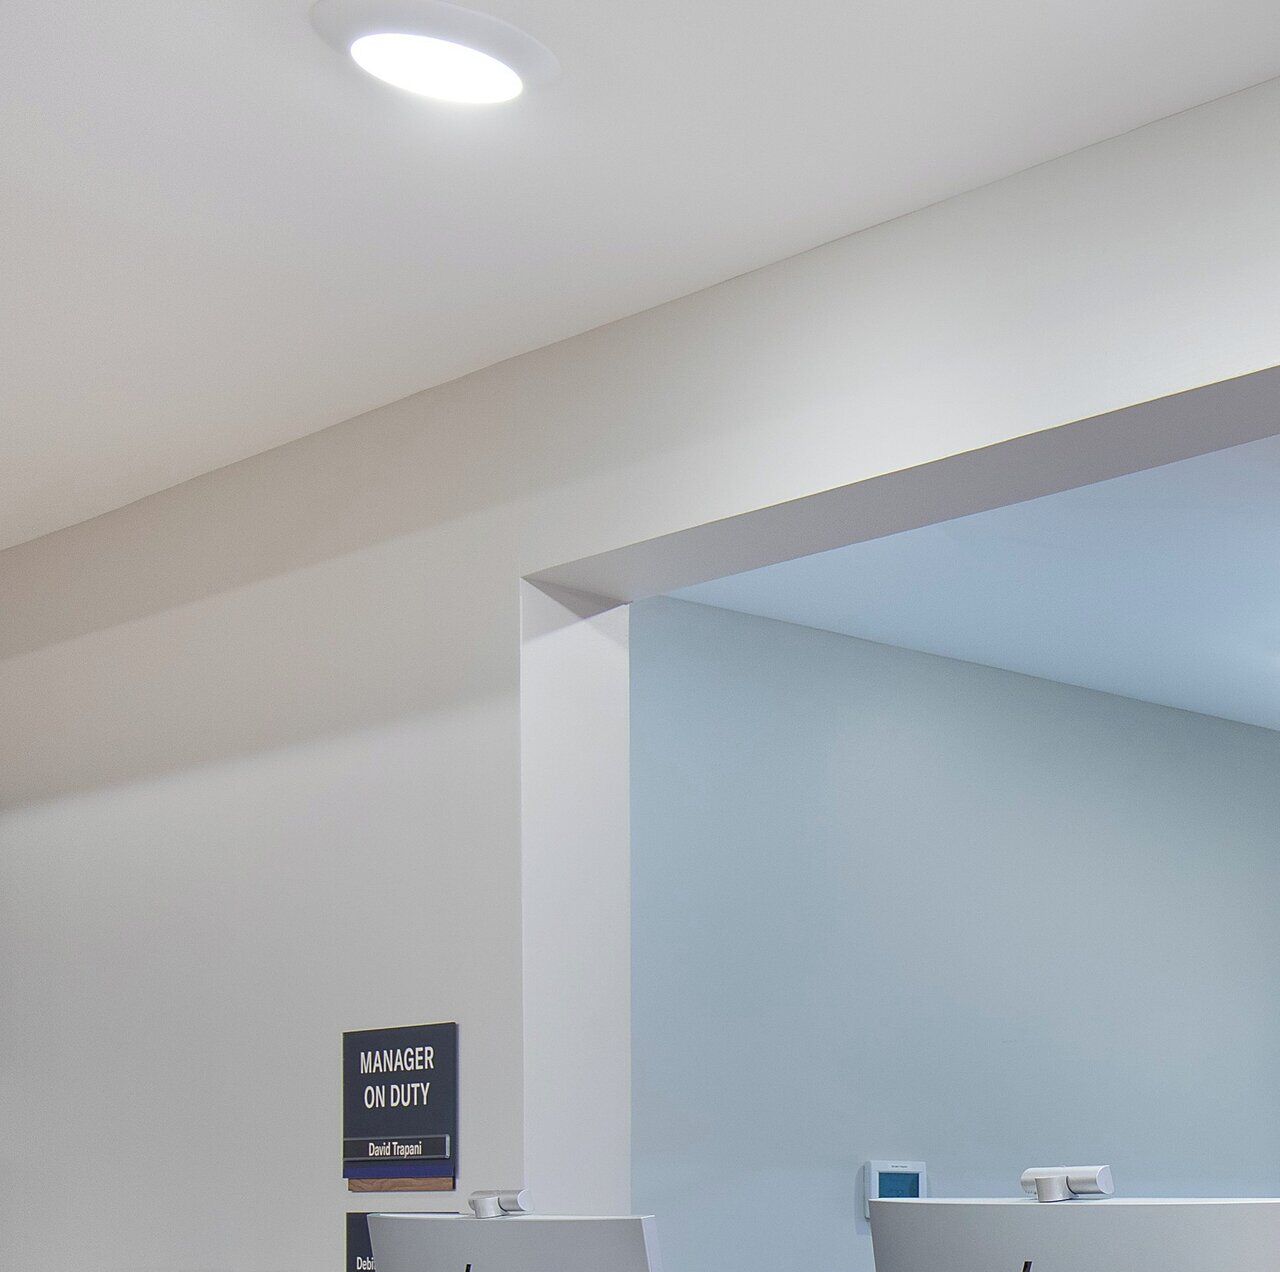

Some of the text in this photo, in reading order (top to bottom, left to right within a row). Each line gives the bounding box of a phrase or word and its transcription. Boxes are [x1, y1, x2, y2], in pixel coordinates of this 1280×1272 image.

[360, 1046, 434, 1074] MANAGER
[364, 1082, 430, 1109] ON DUTY
[368, 1141, 422, 1158] David Trapani
[356, 1256, 376, 1270] Debi
